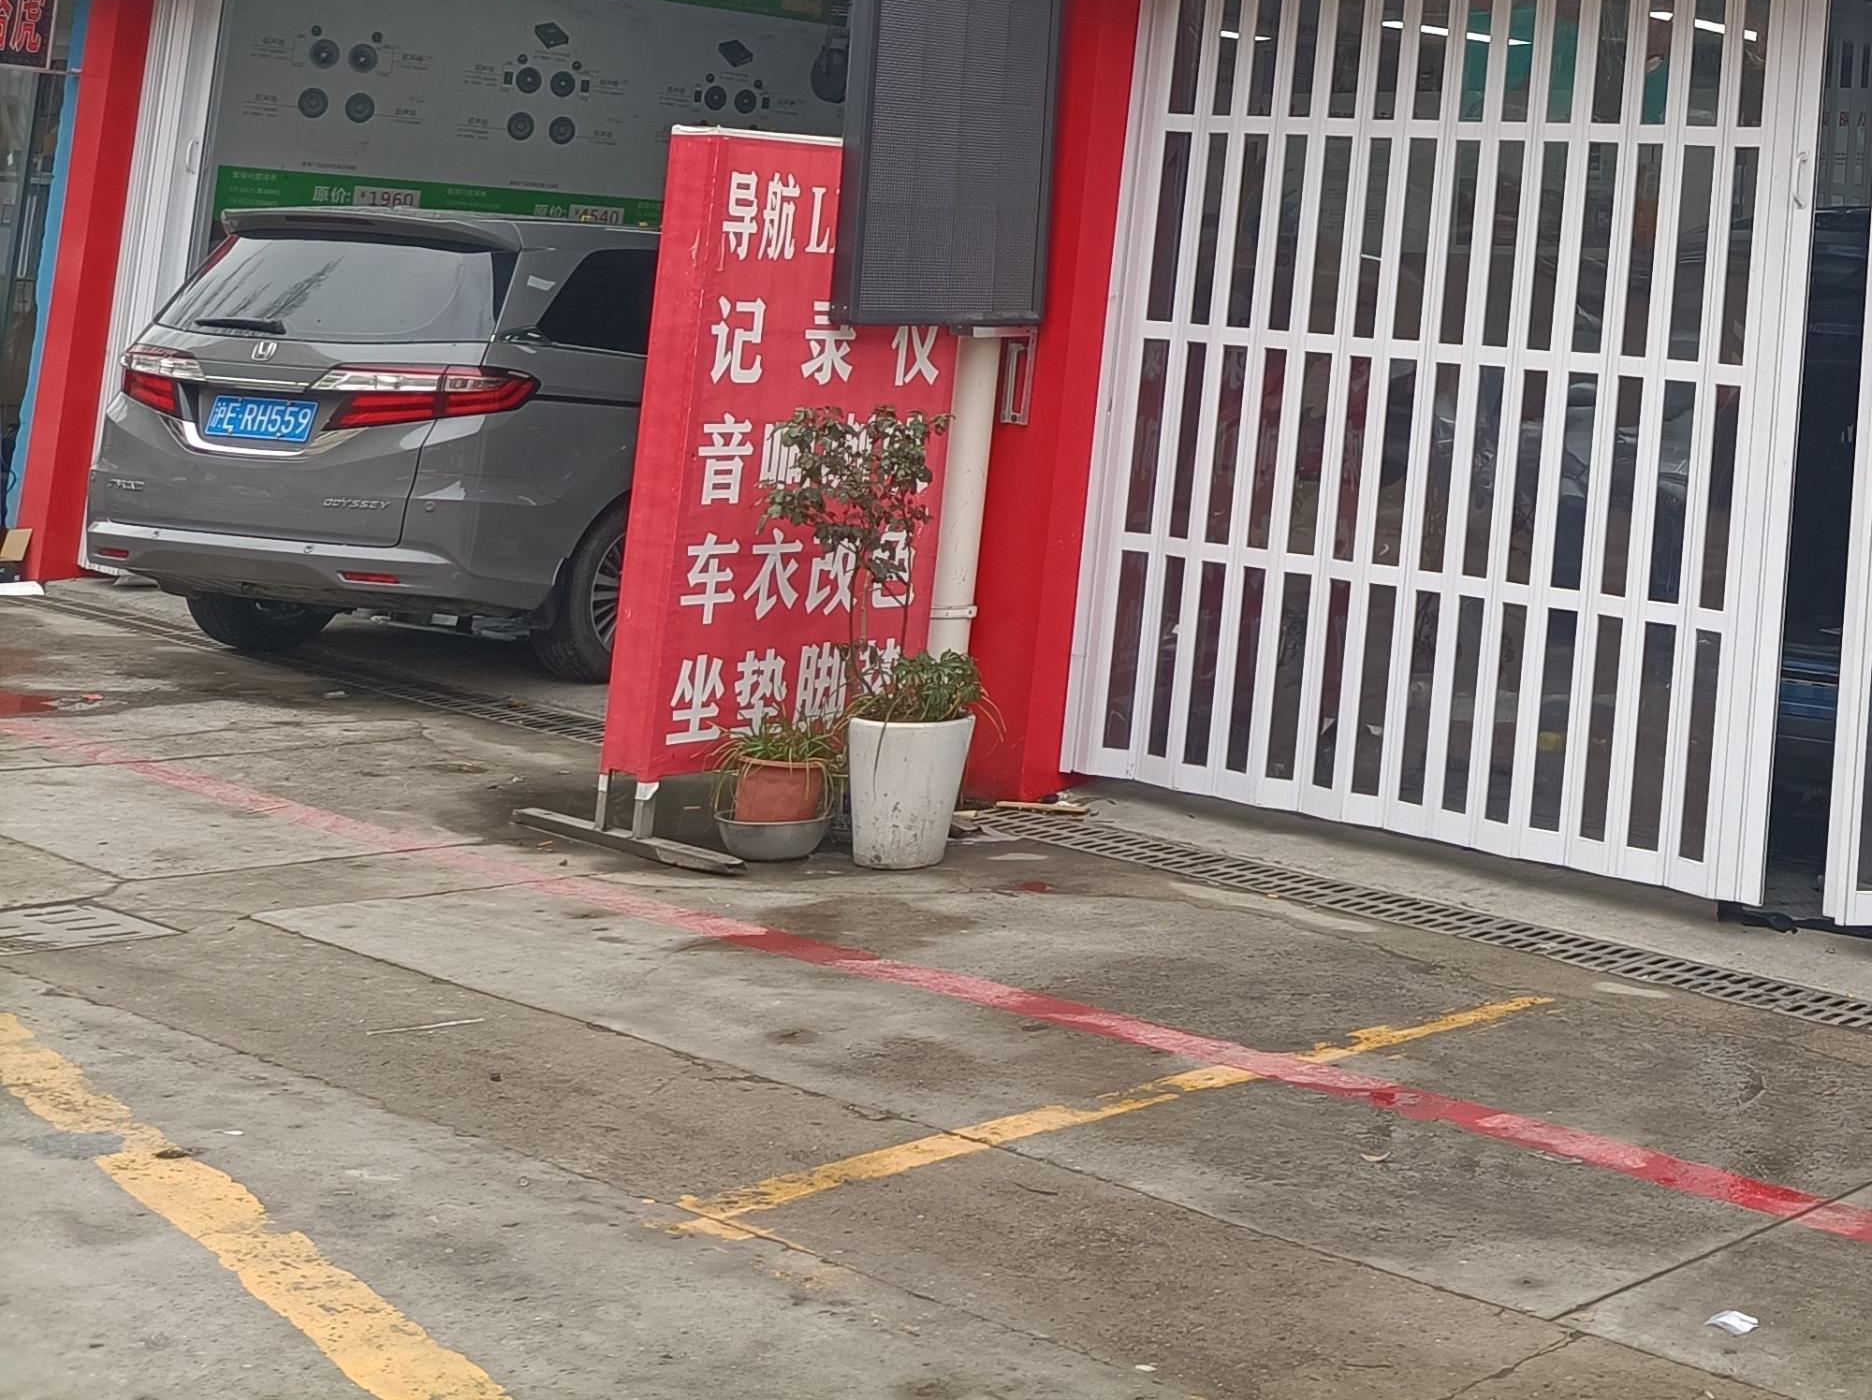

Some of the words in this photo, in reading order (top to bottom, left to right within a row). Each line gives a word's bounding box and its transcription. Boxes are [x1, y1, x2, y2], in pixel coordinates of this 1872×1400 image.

[717, 170, 801, 261] 导航
[804, 186, 841, 254] L
[710, 295, 940, 388] 记录仪
